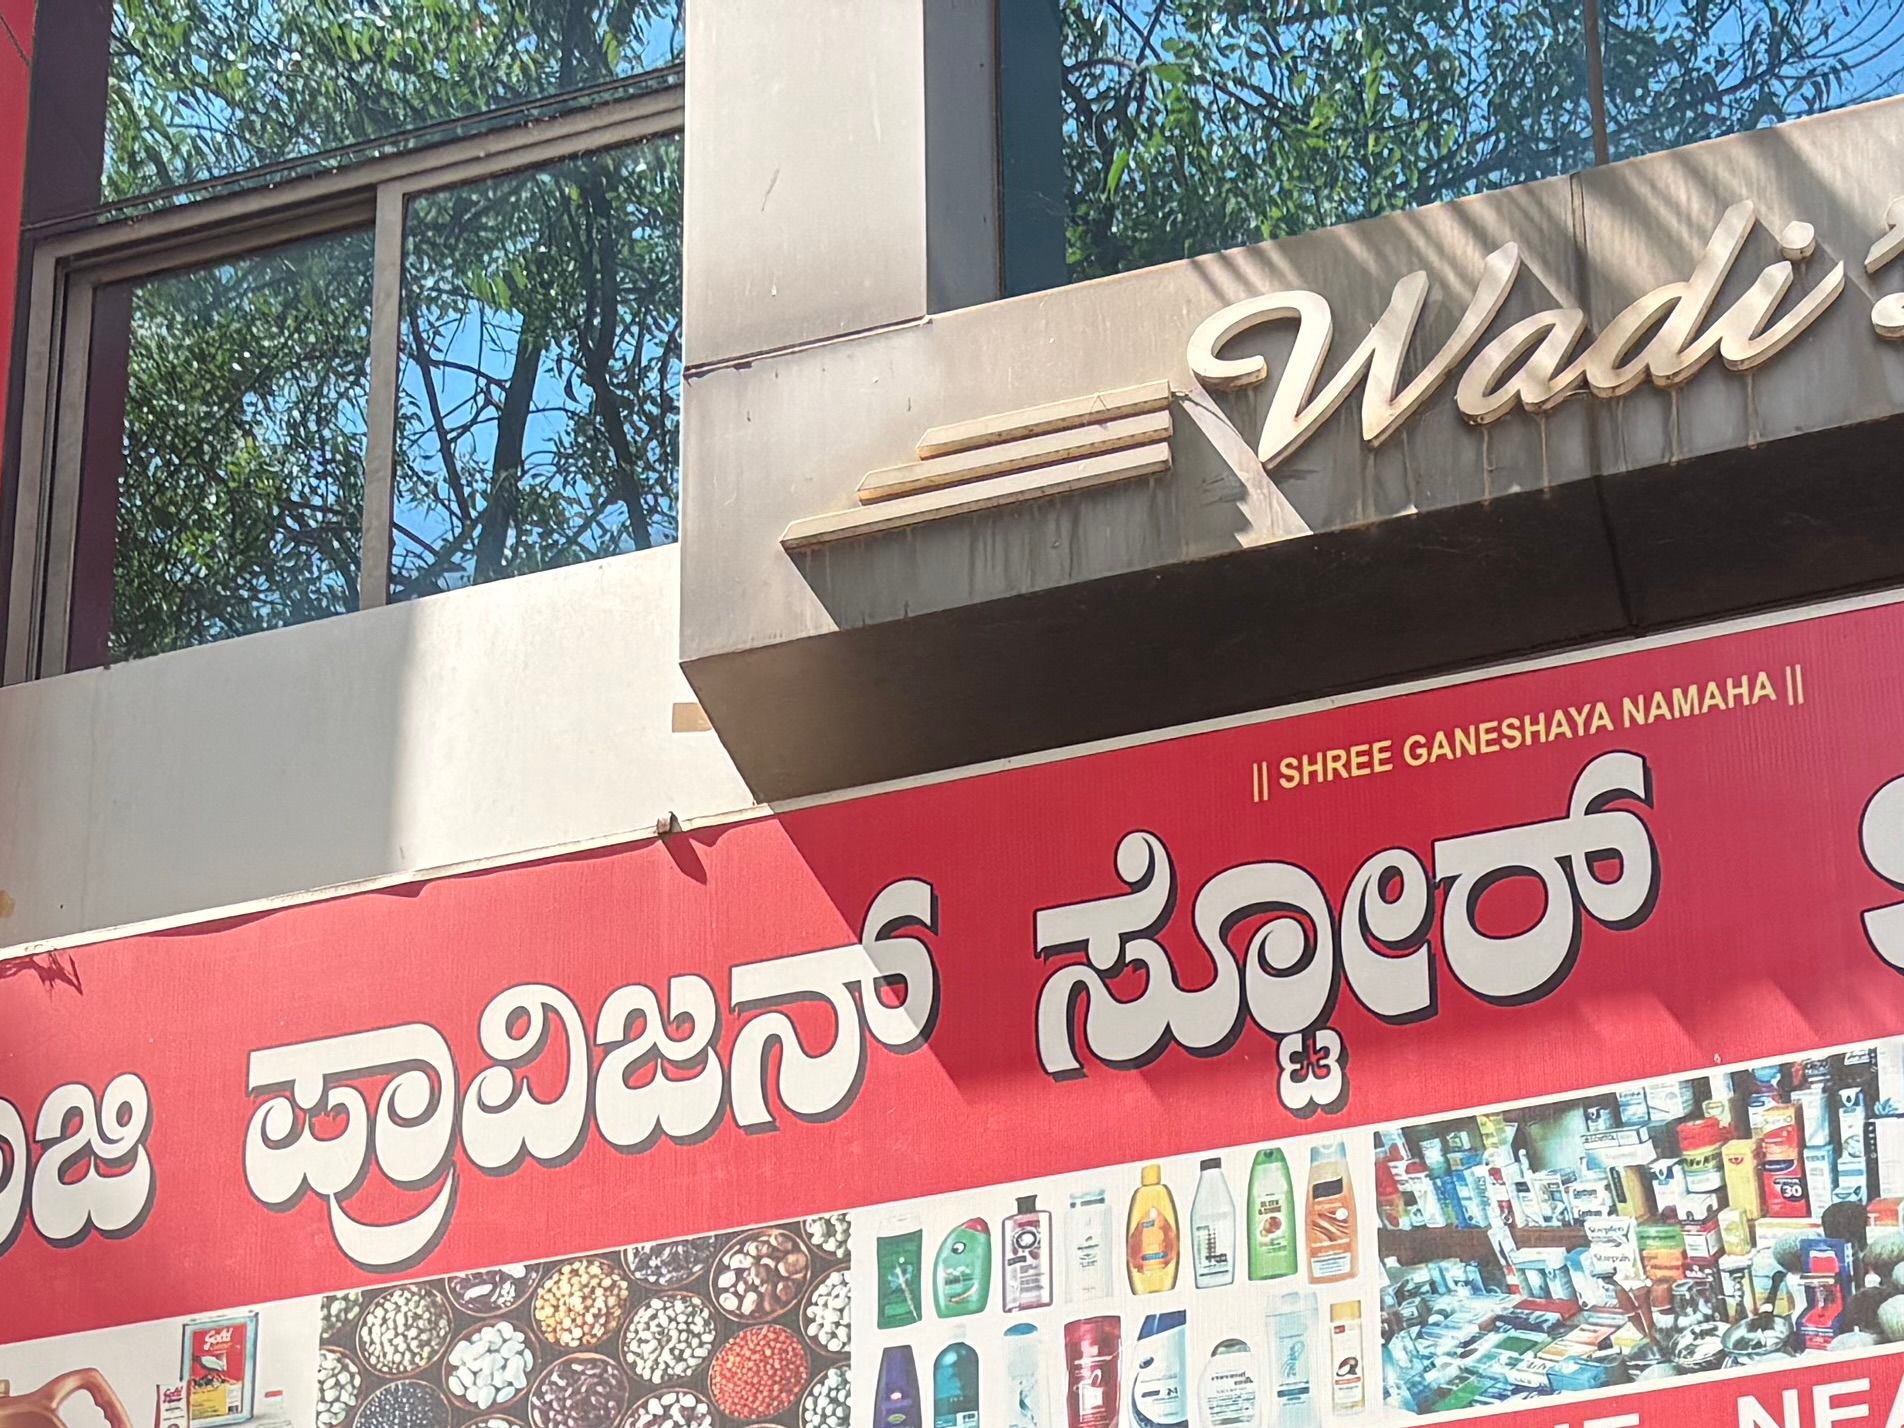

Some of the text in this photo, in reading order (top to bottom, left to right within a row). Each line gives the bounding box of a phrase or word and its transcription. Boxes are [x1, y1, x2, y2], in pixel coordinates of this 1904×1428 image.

[1279, 671, 1777, 790] SHREE GANESHAYA NAMAHA
[246, 880, 938, 1276] ಪ್ರಾವಿಜನ್
[1034, 752, 1658, 1115] ಸ್ಟೋರ್
[1781, 1183, 1802, 1199] 30
[204, 1326, 234, 1352] Gold
